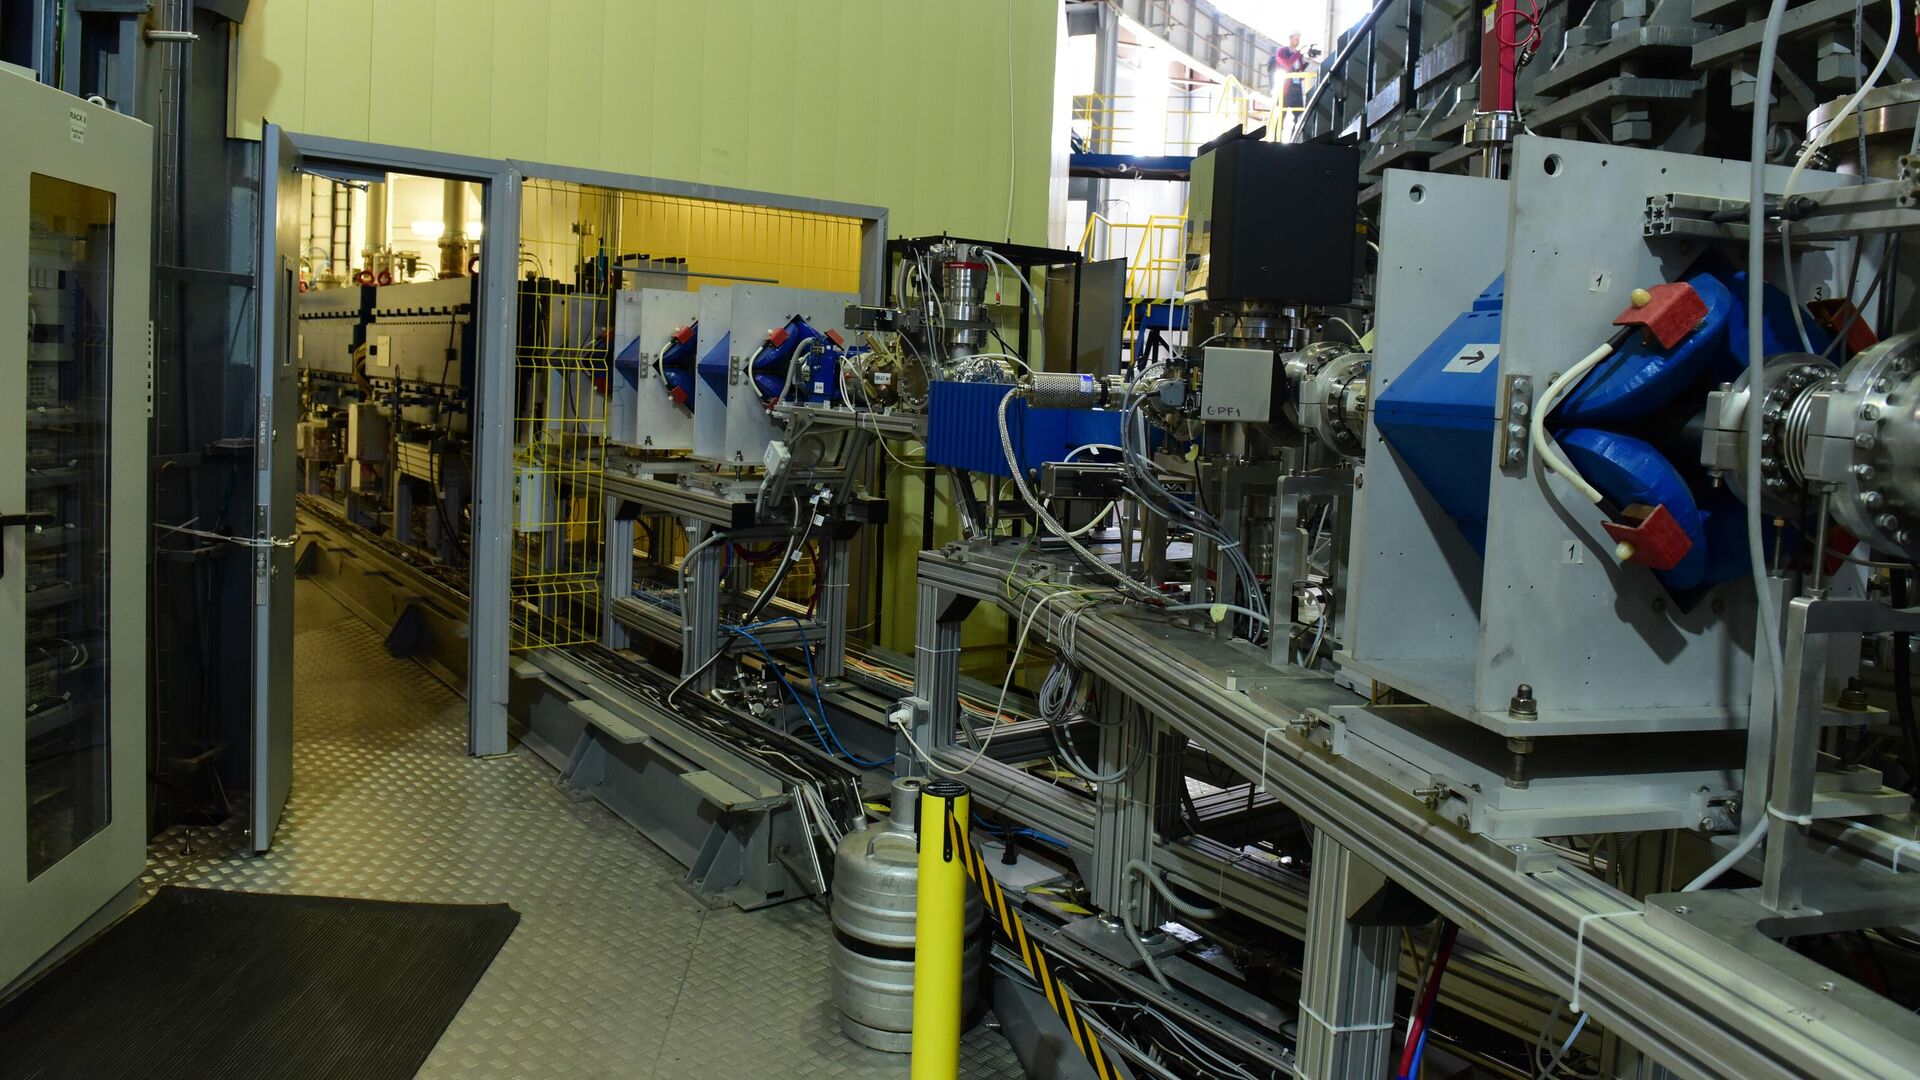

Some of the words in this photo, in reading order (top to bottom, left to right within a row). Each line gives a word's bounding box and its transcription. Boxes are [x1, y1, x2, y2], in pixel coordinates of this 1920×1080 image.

[69, 111, 83, 123] RACK
[1595, 273, 1604, 288] 1
[1814, 286, 1823, 301] 3
[1207, 405, 1241, 418] GPF1
[1568, 543, 1576, 561] 1
